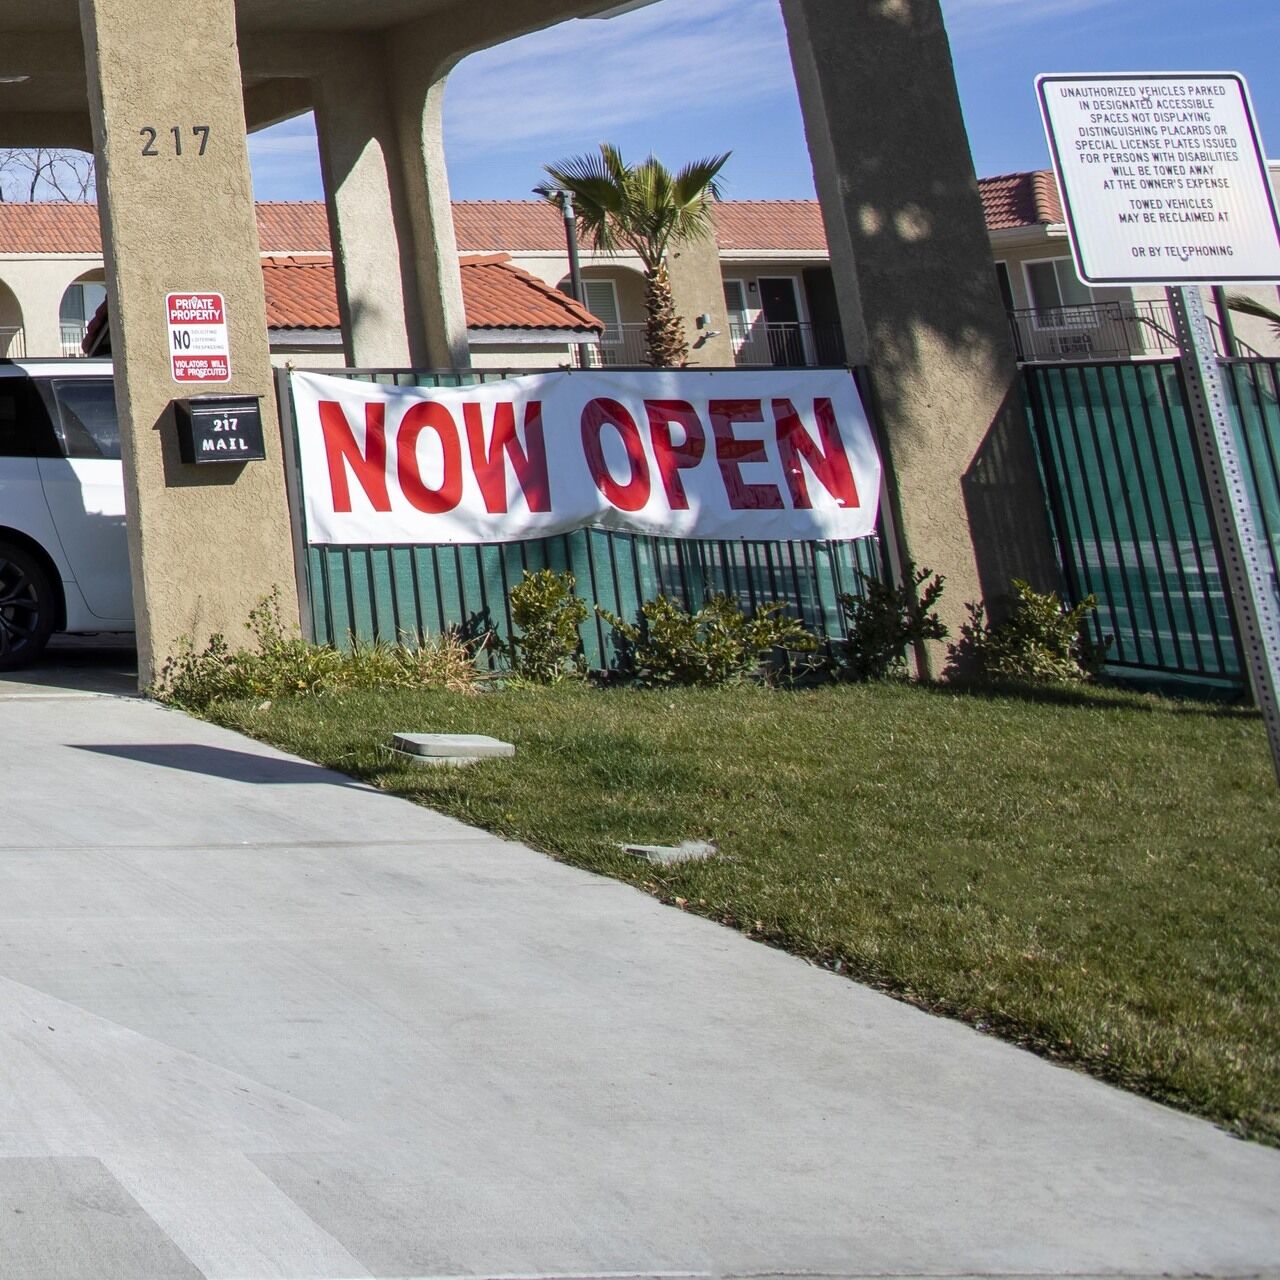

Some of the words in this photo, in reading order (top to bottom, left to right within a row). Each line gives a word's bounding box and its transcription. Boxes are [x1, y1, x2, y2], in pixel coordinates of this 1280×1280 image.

[1061, 87, 1136, 97] UNAUTHORIZED
[1139, 87, 1186, 97] VEHICLES
[1188, 86, 1226, 96] PARKED
[1080, 100, 1090, 110] IN
[1093, 99, 1153, 110] DESIGNATED
[1157, 99, 1215, 109] ACCESSIBLE
[1091, 113, 1129, 123] SPACES
[1132, 113, 1150, 123] NOT
[1154, 113, 1211, 123] DISPLAYING
[1079, 126, 1158, 136] DISTINGUISHING
[1161, 126, 1212, 136] PLACARDS
[1214, 126, 1227, 135] OR
[140, 126, 210, 156] 217
[1076, 140, 1118, 150] SPECIAL
[1120, 139, 1162, 149] LICENSE
[1165, 139, 1201, 149] PLATES
[1202, 139, 1237, 149] ISSUED
[1079, 153, 1100, 163] FOR
[1103, 153, 1150, 163] PERSONS
[1152, 153, 1176, 162] WITH
[1178, 152, 1239, 162] DISABILITIES
[1112, 167, 1135, 176] WILL
[1138, 166, 1152, 176] BE
[1154, 166, 1186, 176] TOWED
[1190, 166, 1213, 175] AWAY
[1104, 180, 1114, 190] AT
[1118, 180, 1137, 190] THE
[1140, 179, 1184, 189] OWNER'S
[1187, 179, 1229, 189] EXPENSE
[1130, 200, 1163, 210] TOWED
[1166, 199, 1214, 209] VEHICLES
[1119, 214, 1139, 223] MAY
[1143, 213, 1157, 223] BE
[1159, 212, 1215, 222] RECLAIMED
[1219, 212, 1228, 222] AT
[1132, 247, 1146, 257] OR
[1149, 247, 1161, 257] BY
[1165, 246, 1234, 257] TELEPHONING
[176, 299, 214, 309] PRIVATE
[171, 310, 220, 320] PROPERTY
[173, 330, 190, 350] NO
[175, 360, 208, 368] VIOLATORS
[188, 368, 226, 376] PROSECUTED
[214, 419, 238, 431] 217
[202, 438, 248, 451] MAIL
[318, 399, 552, 514] NOW
[580, 397, 860, 511] OPEN
